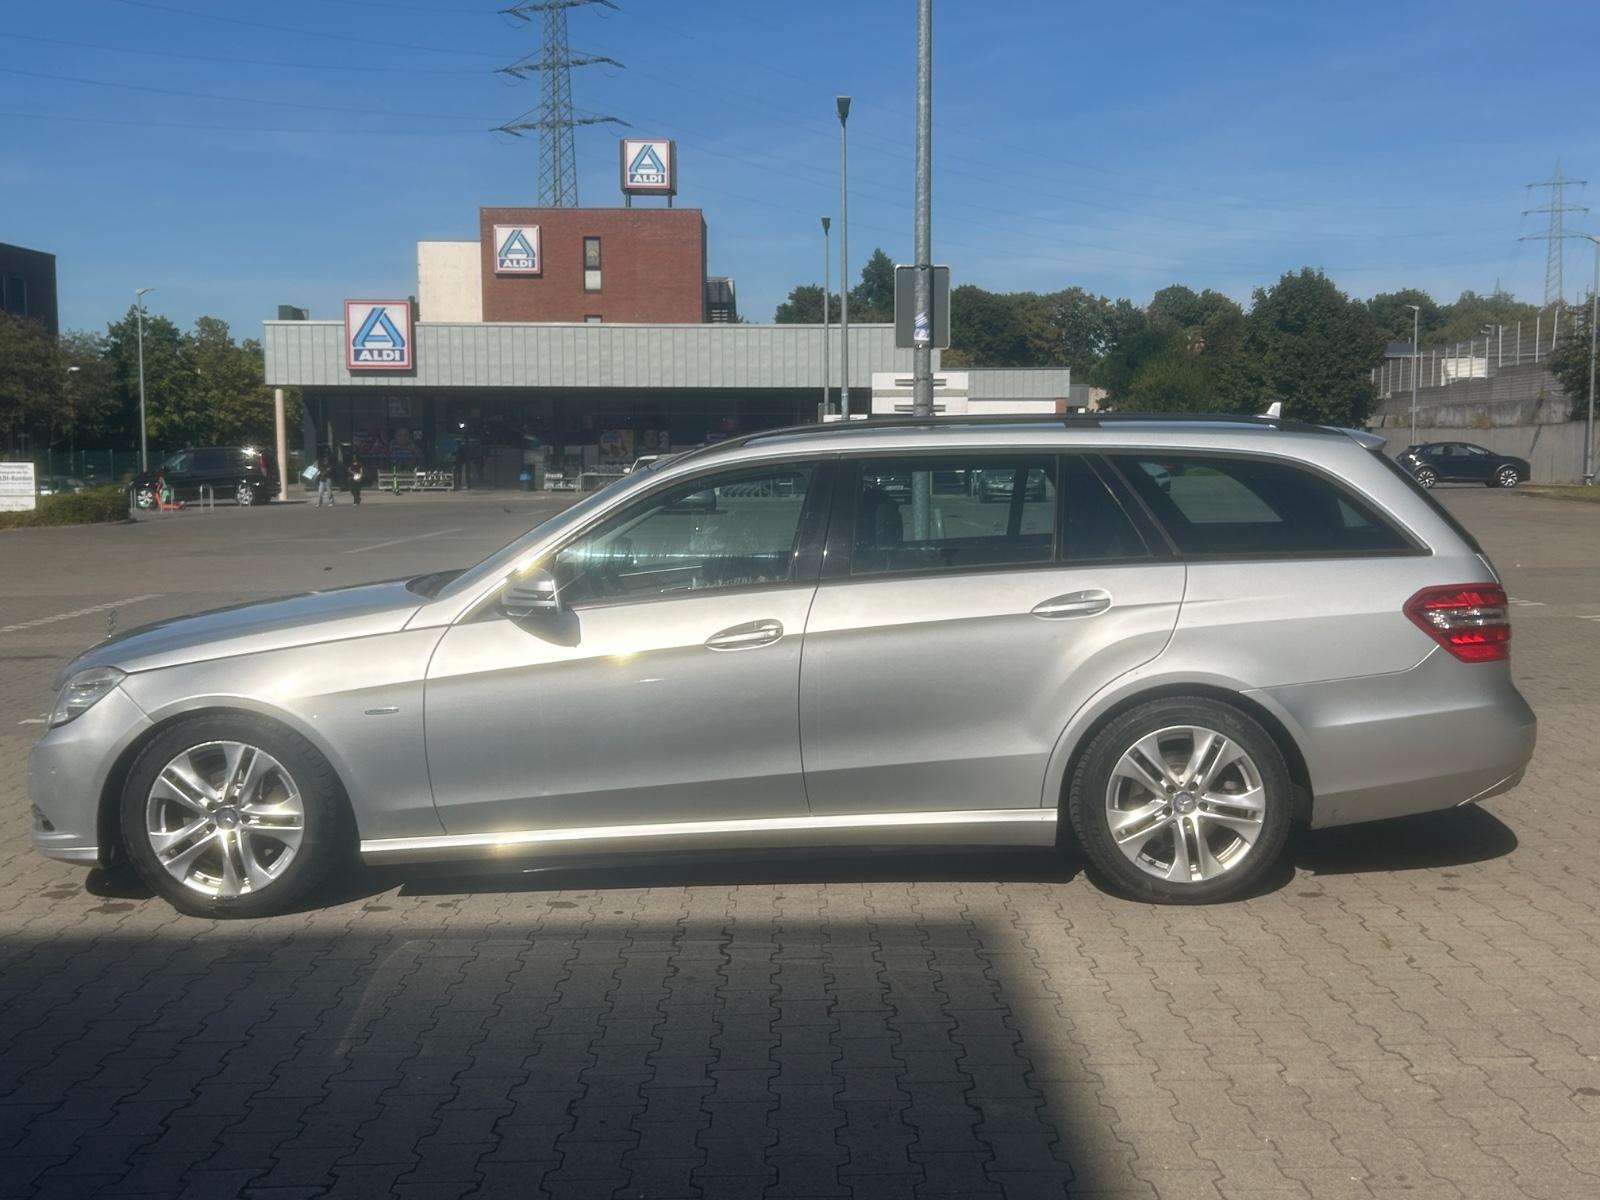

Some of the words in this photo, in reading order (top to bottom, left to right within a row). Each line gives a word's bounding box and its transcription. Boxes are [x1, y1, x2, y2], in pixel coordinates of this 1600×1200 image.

[633, 174, 662, 183] ALDI
[503, 260, 533, 268] ALDI
[359, 350, 401, 361] ALDI
